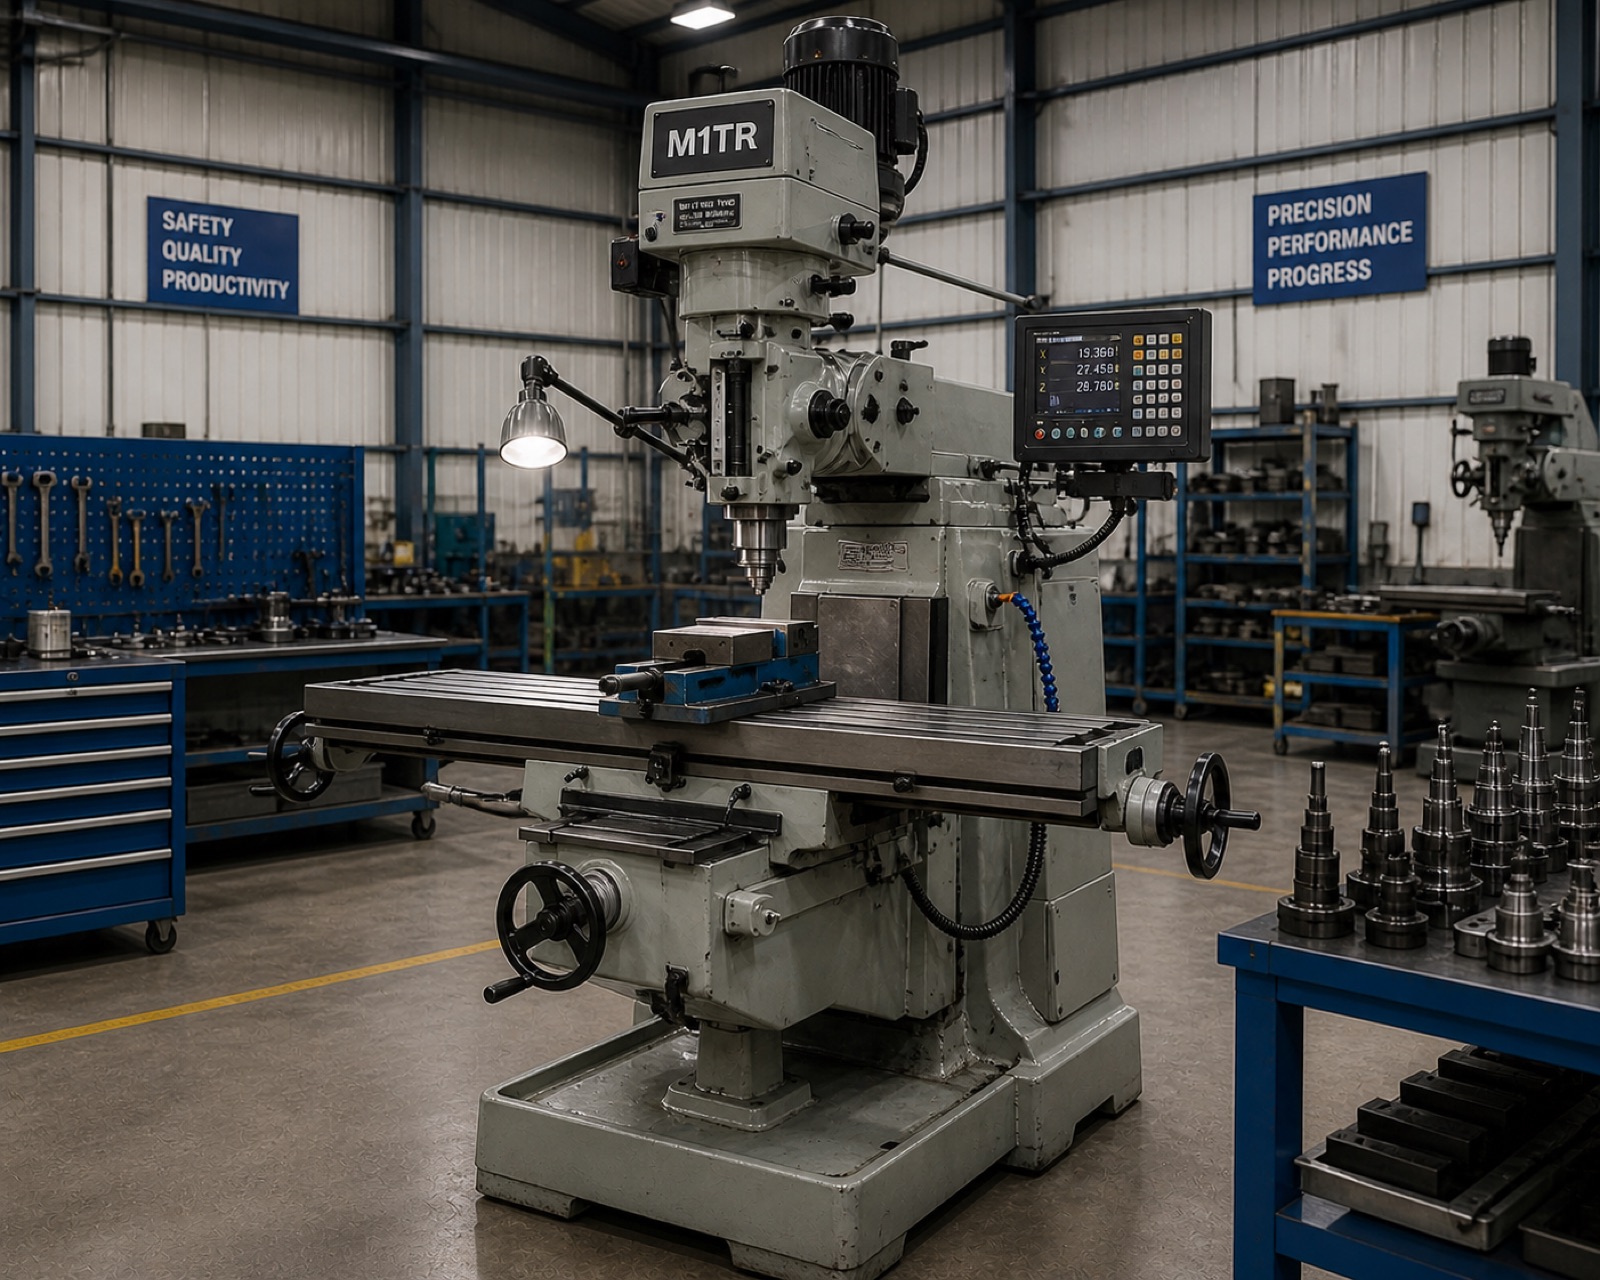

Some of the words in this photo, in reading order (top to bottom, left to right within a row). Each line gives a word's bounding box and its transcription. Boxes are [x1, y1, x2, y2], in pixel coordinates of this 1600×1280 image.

[667, 121, 758, 158] M1TR
[162, 210, 234, 237] SAFETY
[1267, 192, 1372, 227] PRECISION
[162, 239, 242, 267] QUALITY
[1267, 220, 1413, 258] PERFORMANCE
[162, 269, 290, 300] PRODUCTIVITY
[1267, 258, 1372, 290] PROGRESS
